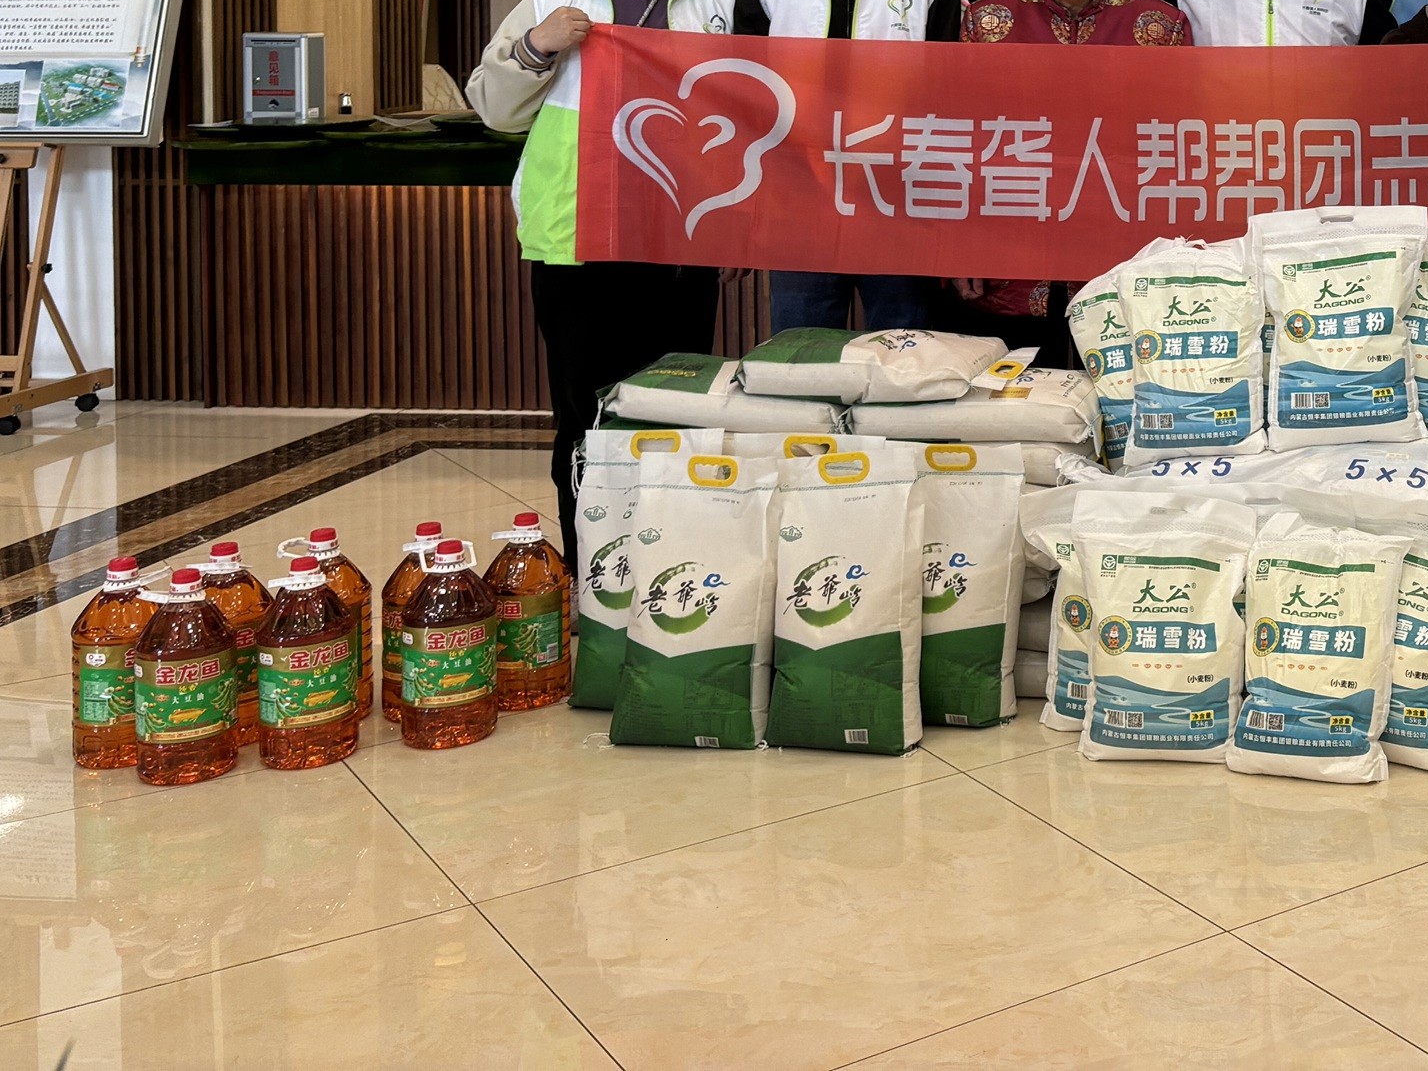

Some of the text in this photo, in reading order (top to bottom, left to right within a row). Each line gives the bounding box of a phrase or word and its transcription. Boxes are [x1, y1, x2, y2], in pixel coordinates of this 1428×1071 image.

[1314, 278, 1365, 302] 大公
[1163, 295, 1212, 318] 大公
[1313, 297, 1365, 309] DAGONG
[1162, 318, 1210, 327] DAGONG
[1318, 312, 1386, 336] 瑞雪粉
[1164, 336, 1229, 357] 瑞雪粉
[1133, 579, 1191, 604] 大公
[1282, 584, 1339, 608] 大公
[1132, 606, 1189, 614] DAGONG
[1281, 608, 1338, 619] DAGONG
[427, 625, 486, 652] 金龙鱼
[1135, 626, 1207, 650] 瑞雪粉
[1281, 627, 1356, 653] 瑞雪粉
[289, 640, 349, 671] 金龙鱼
[156, 659, 221, 685] 金龙鱼
